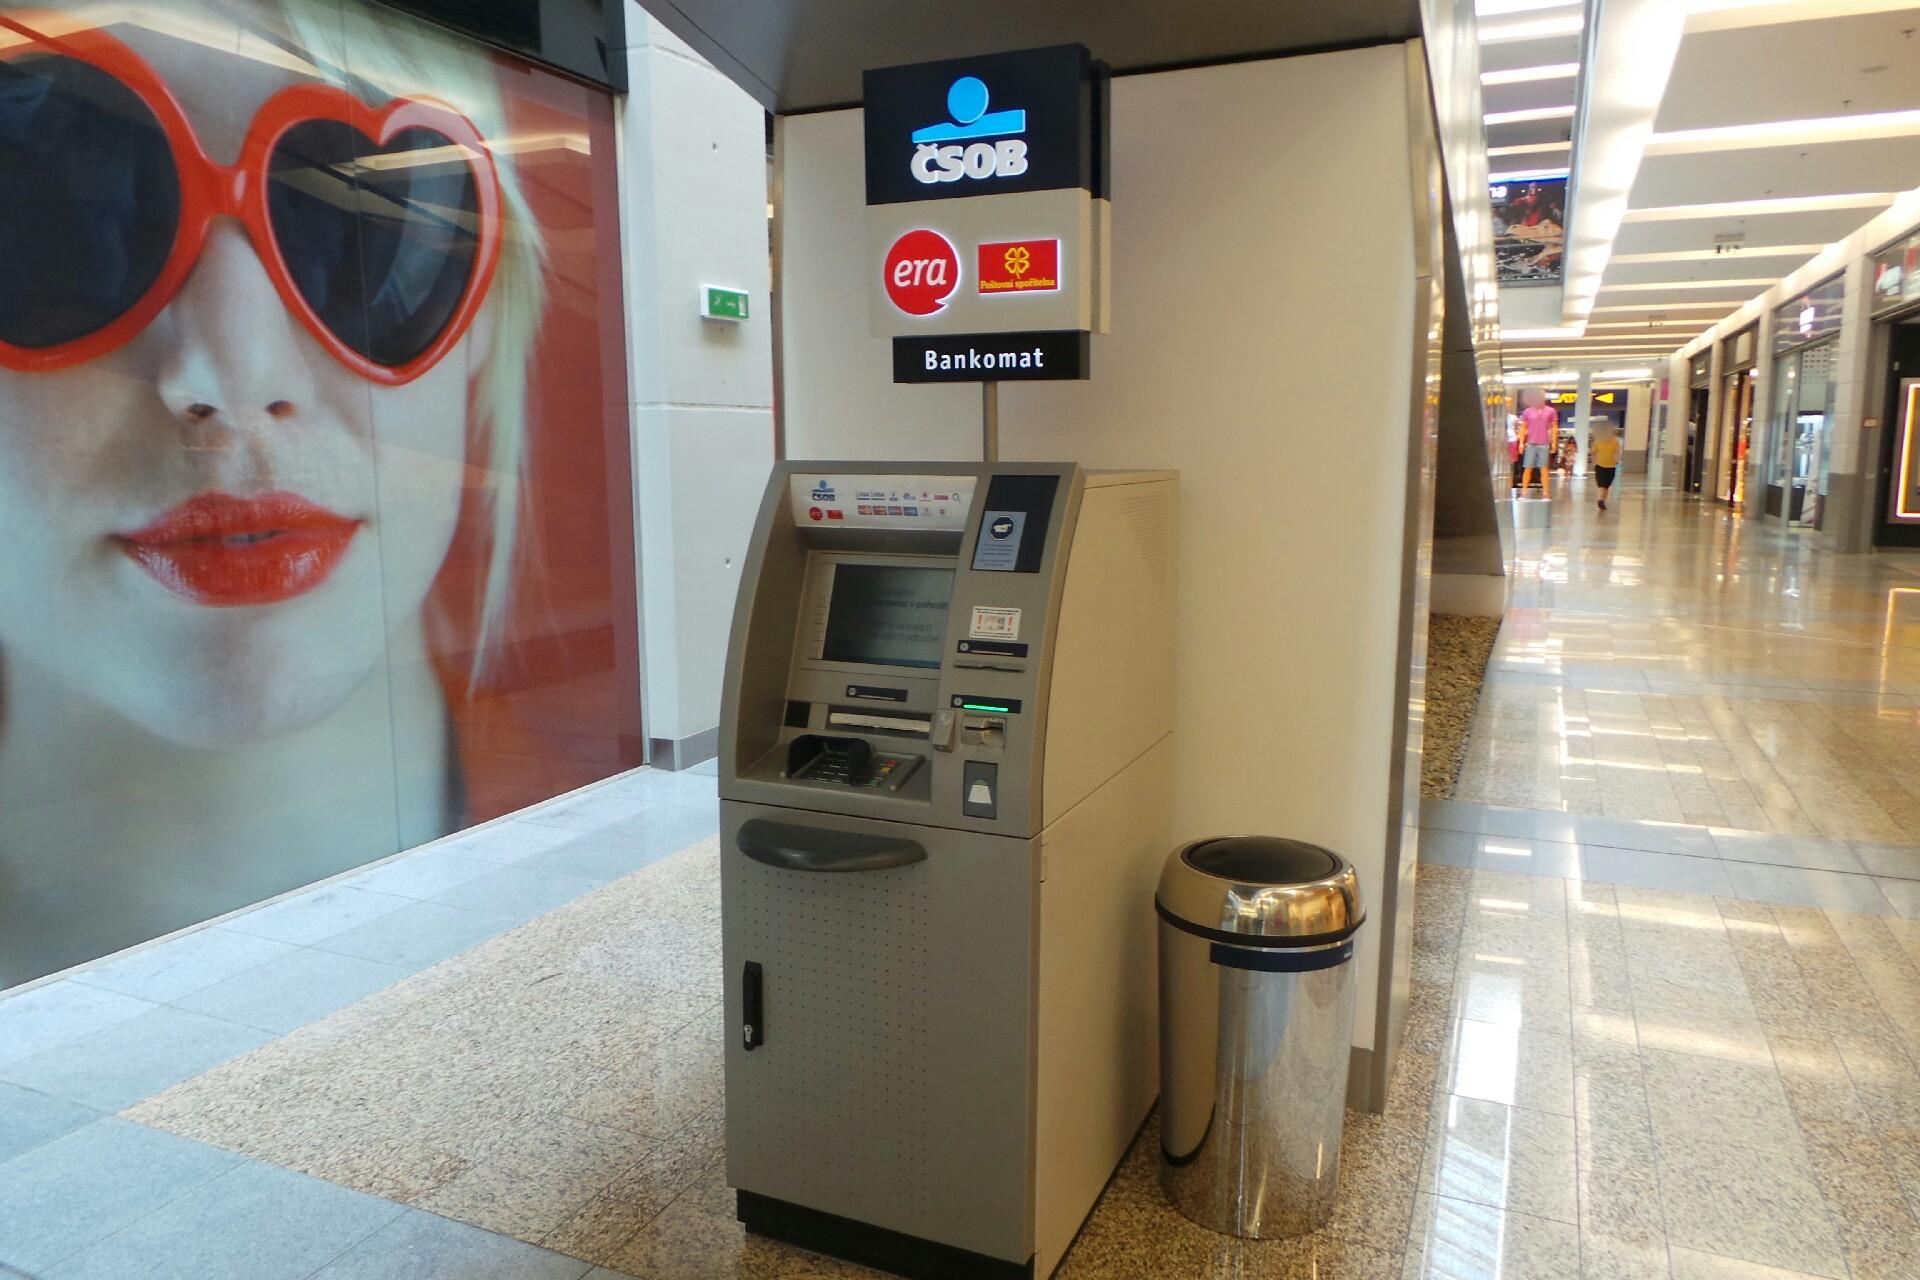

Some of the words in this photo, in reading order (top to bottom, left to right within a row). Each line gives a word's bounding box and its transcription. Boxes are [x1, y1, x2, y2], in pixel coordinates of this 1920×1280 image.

[910, 139, 1028, 184] ČSOB
[894, 258, 947, 287] era
[925, 348, 1044, 370] Bankomat
